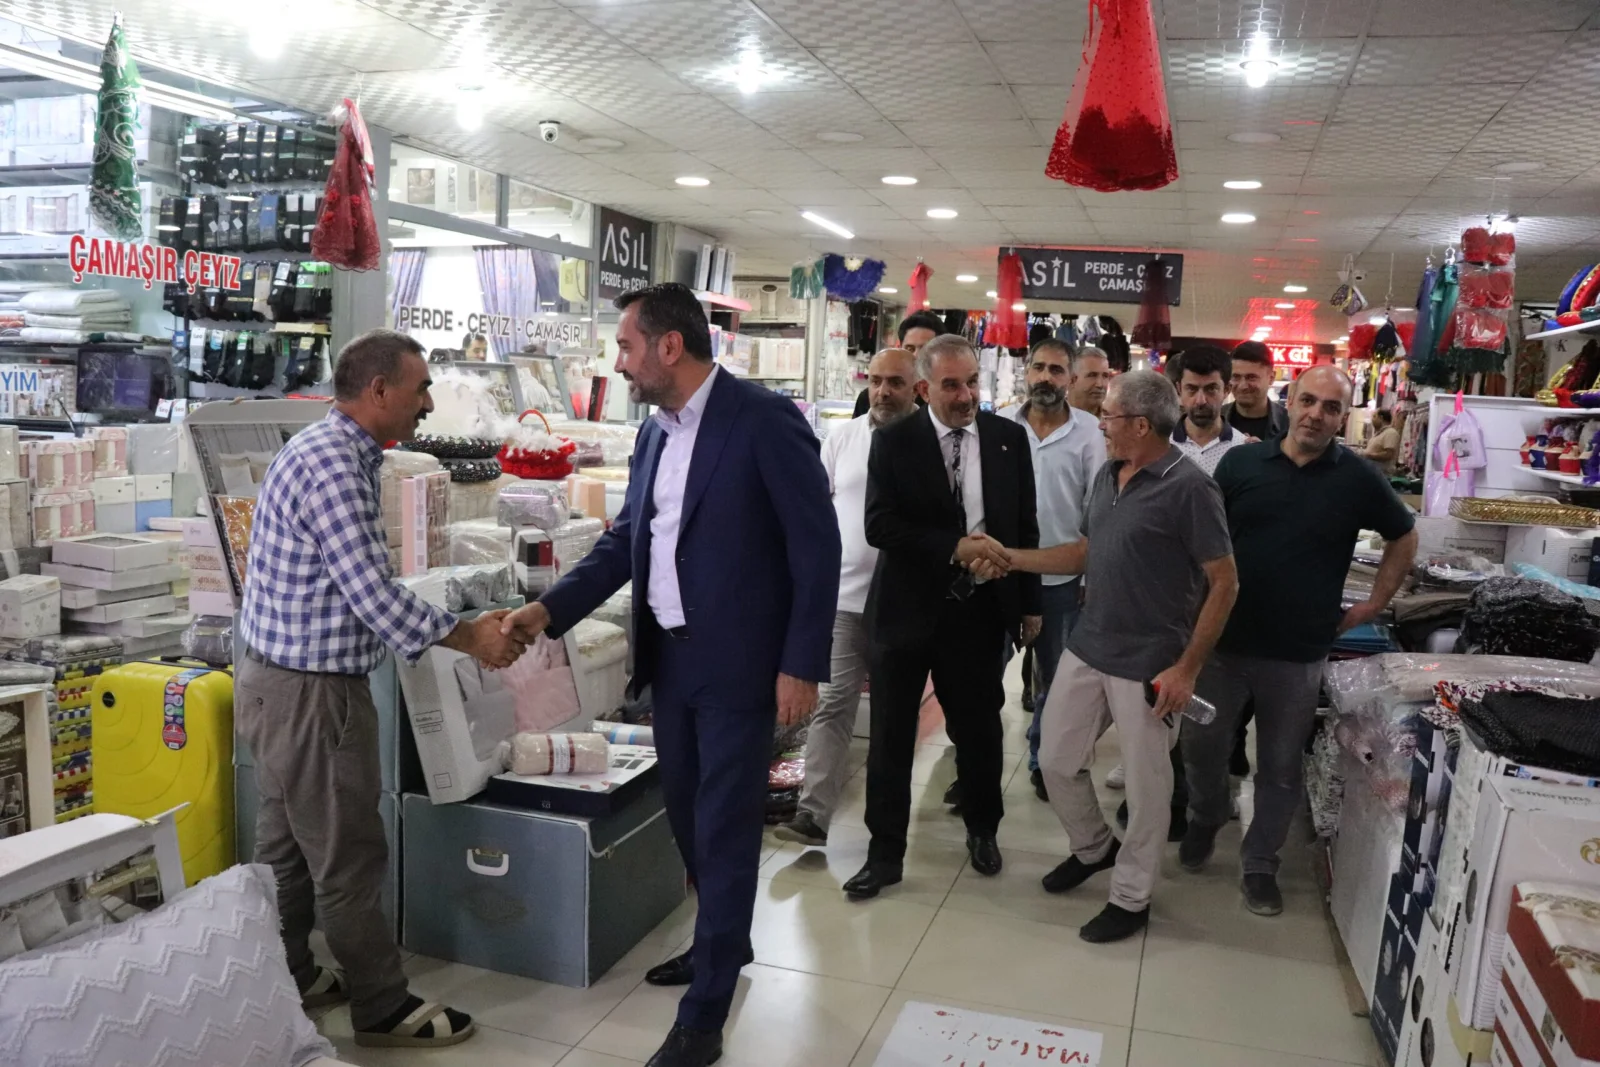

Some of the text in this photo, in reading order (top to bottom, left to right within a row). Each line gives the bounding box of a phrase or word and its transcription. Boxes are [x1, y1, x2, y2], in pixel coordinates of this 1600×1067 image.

[70, 234, 178, 289] ÇAMAŞIR
[1084, 262, 1124, 275] PERDE
[600, 270, 621, 288] PERDE
[622, 278, 630, 289] ve
[1099, 277, 1149, 293] ÇAMAŞ
[400, 306, 453, 331] PERDE
[467, 311, 510, 338] ÇEYİZ
[525, 320, 581, 343] ÇAMAŞIR
